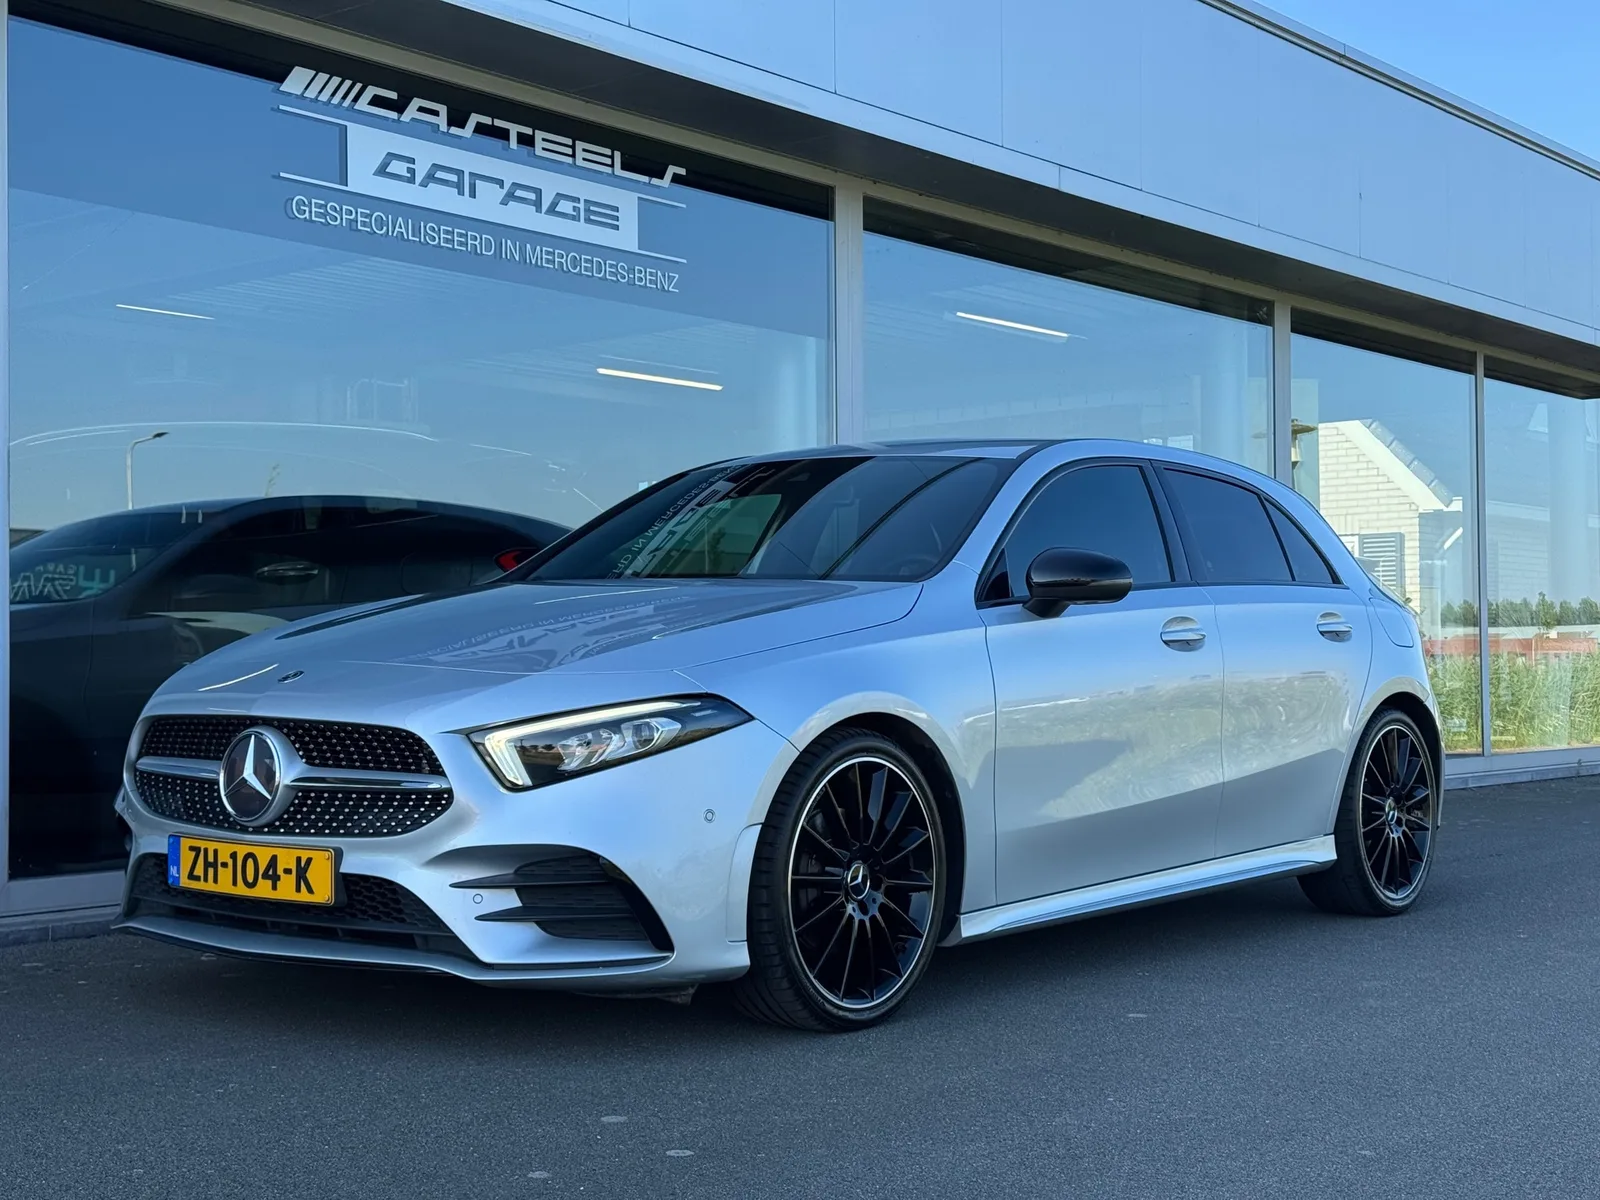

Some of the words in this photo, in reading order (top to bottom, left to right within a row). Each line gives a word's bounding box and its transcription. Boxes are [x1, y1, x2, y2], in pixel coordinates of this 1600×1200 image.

[353, 85, 687, 188] CASTEELS
[372, 151, 620, 231] GARAGE
[292, 195, 495, 257] GESPECIALISEERD
[501, 238, 520, 262] IN
[526, 243, 680, 293] MERCEDES-BENZ
[169, 864, 180, 877] NL
[187, 844, 315, 895] ZH-104-K
